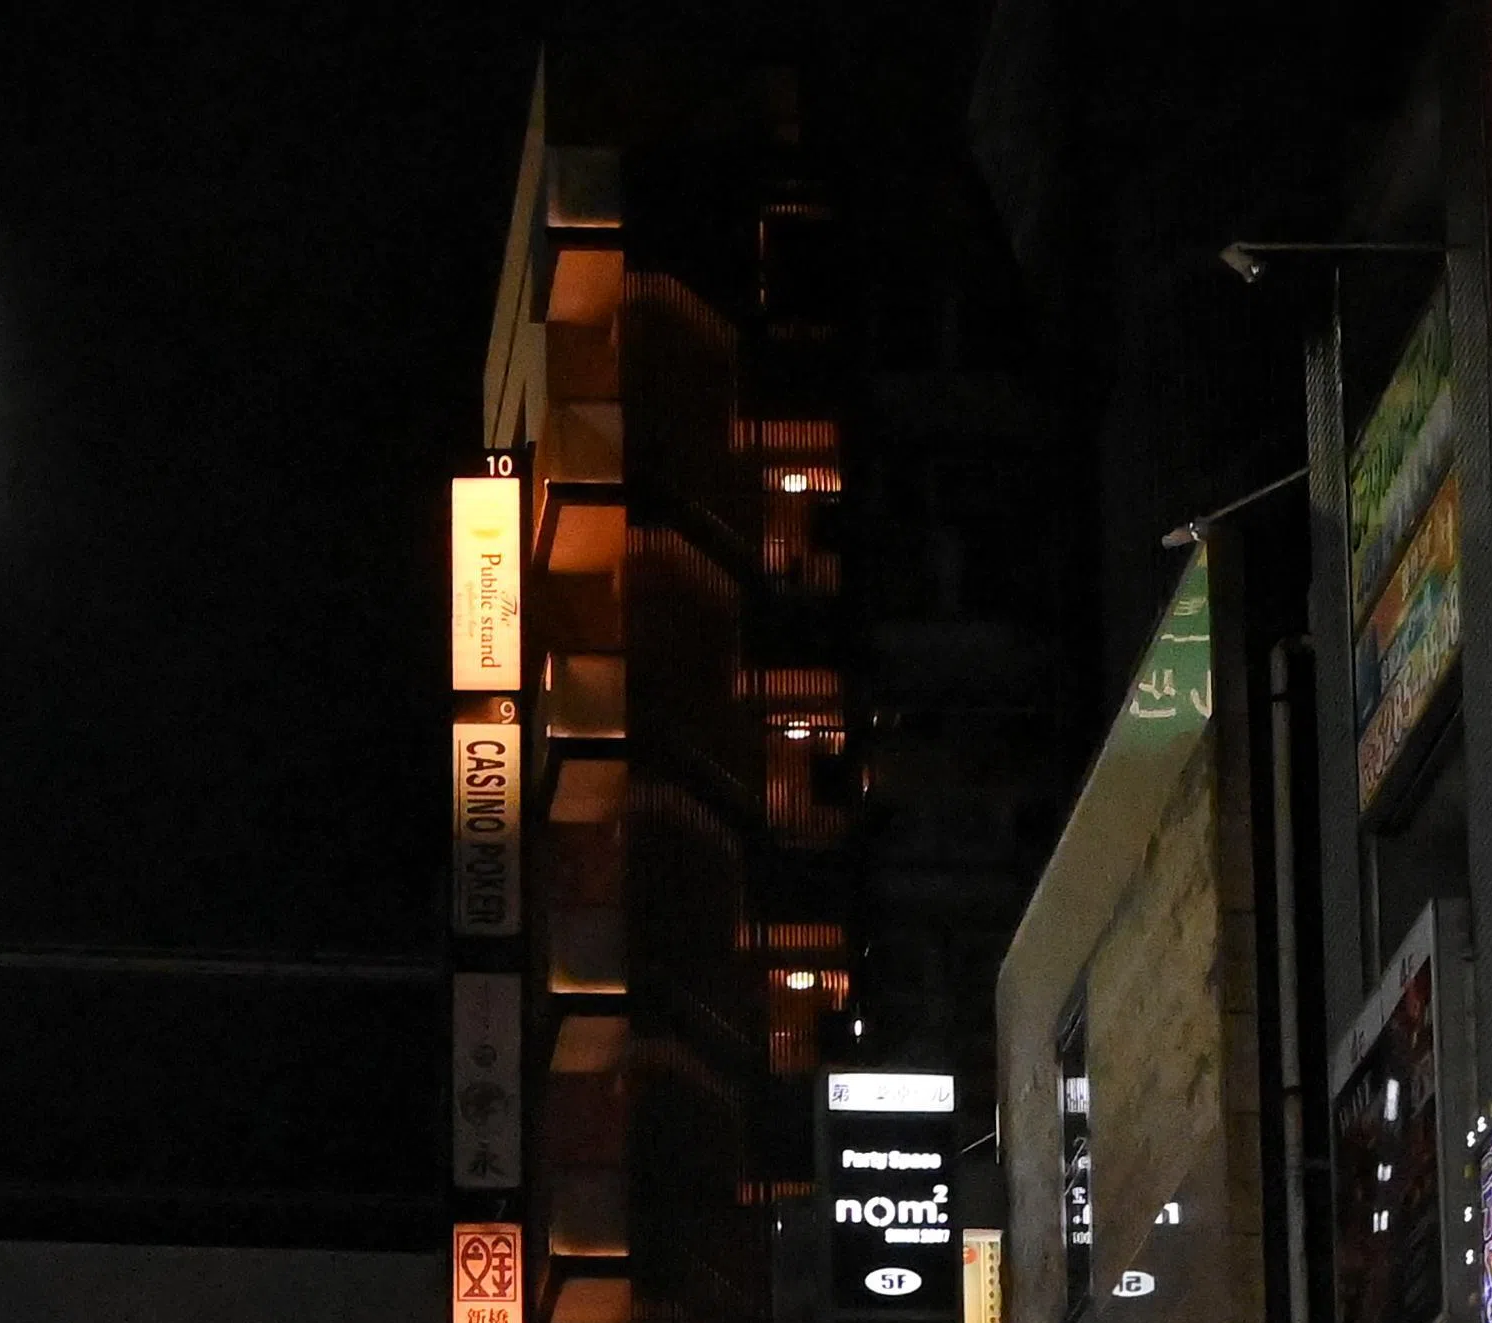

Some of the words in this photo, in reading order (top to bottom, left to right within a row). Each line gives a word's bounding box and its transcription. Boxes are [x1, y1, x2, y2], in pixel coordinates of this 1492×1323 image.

[487, 455, 512, 476] 10
[481, 553, 502, 609] Public
[481, 615, 502, 668] stand
[499, 701, 516, 724] 9
[466, 740, 507, 834] CASINO
[881, 1274, 907, 1289] 5F
